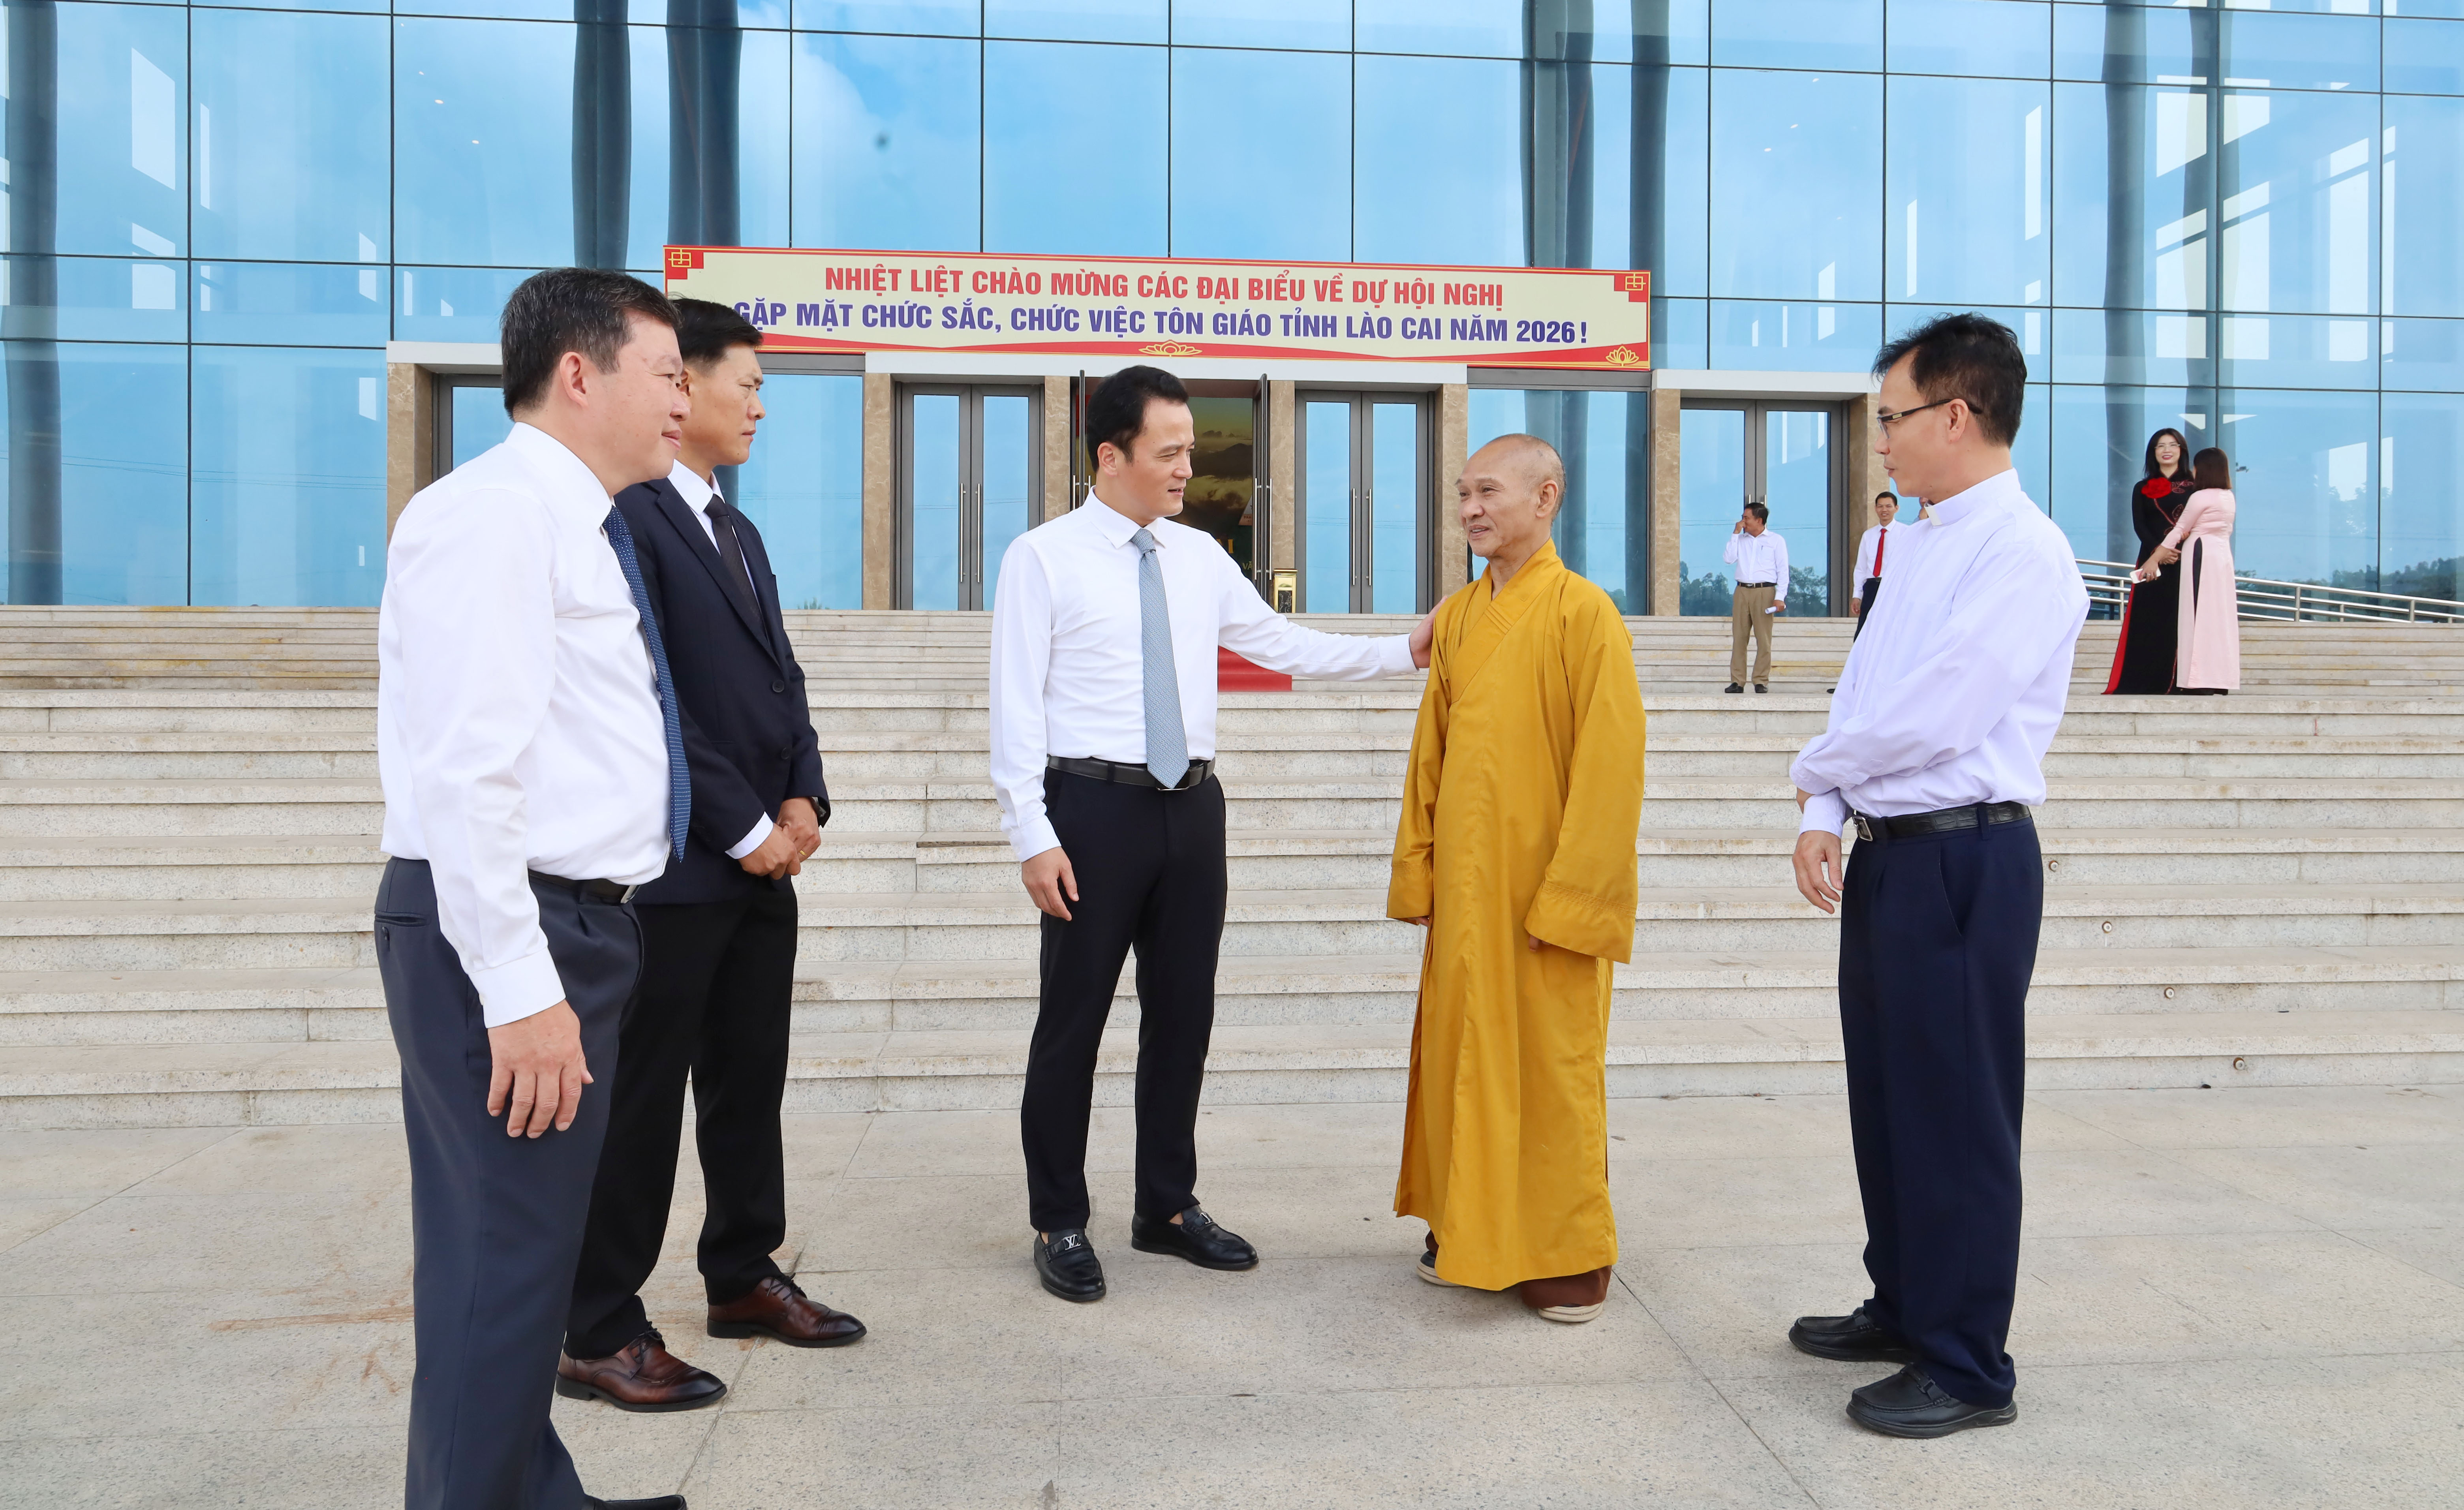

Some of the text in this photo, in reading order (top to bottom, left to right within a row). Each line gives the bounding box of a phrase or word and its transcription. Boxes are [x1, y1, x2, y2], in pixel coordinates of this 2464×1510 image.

[826, 263, 1502, 311] NHIỆT LIỆT CHÀO MỪNG CÁC ĐẠI BIỂU VỀ DỰ HỘI NGHỊ
[734, 297, 787, 331] GẶP
[796, 299, 853, 332] MẶT
[862, 300, 932, 329] CHỨC
[941, 298, 1001, 333] SẮC,
[1010, 304, 1080, 332] CHỨC
[1088, 305, 1145, 338] VIỆC
[1153, 306, 1203, 335] TÔN
[1213, 308, 1271, 336] GIÁO
[1280, 306, 1337, 338] TỈNH
[1346, 311, 1392, 339] LÀO
[1401, 317, 1441, 340] CAI
[1450, 314, 1507, 342] NĂM
